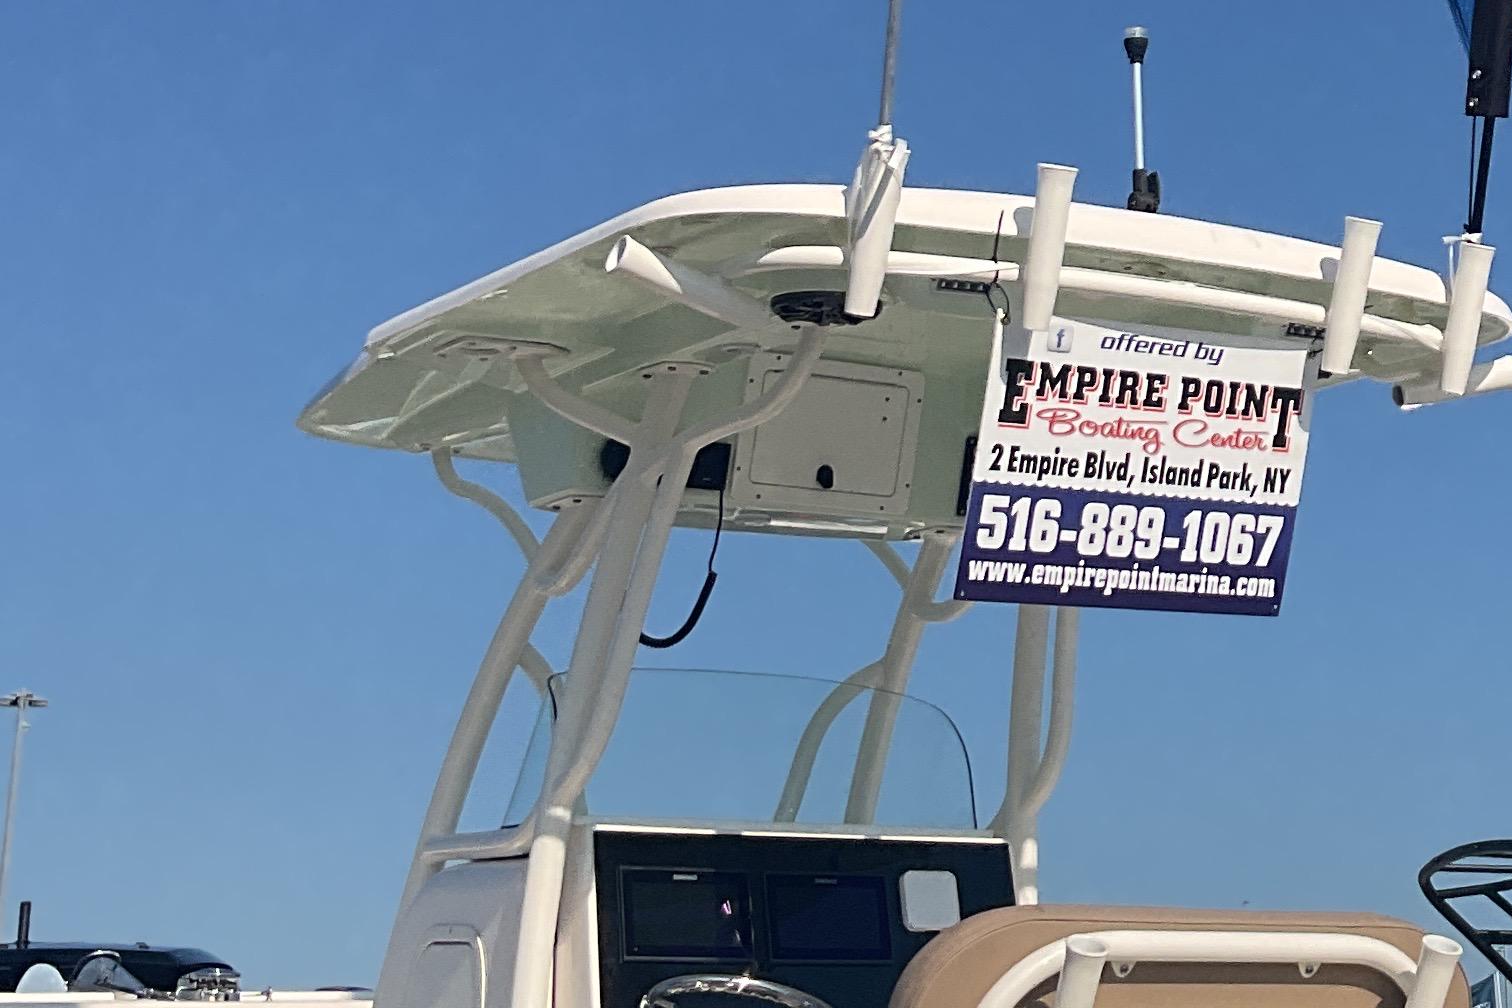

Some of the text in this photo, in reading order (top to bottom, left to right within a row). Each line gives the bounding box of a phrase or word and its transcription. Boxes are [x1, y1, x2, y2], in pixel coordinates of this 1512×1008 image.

[1100, 333, 1225, 366] offered by
[998, 358, 1304, 452] EMPIRE POINT
[1036, 407, 1270, 455] Boating Center
[989, 443, 1292, 497] 2 Empire Blvd, Island Park, NY
[976, 494, 1286, 567] 516-889-1067
[968, 559, 1276, 598] www.empirepointmarina.com
